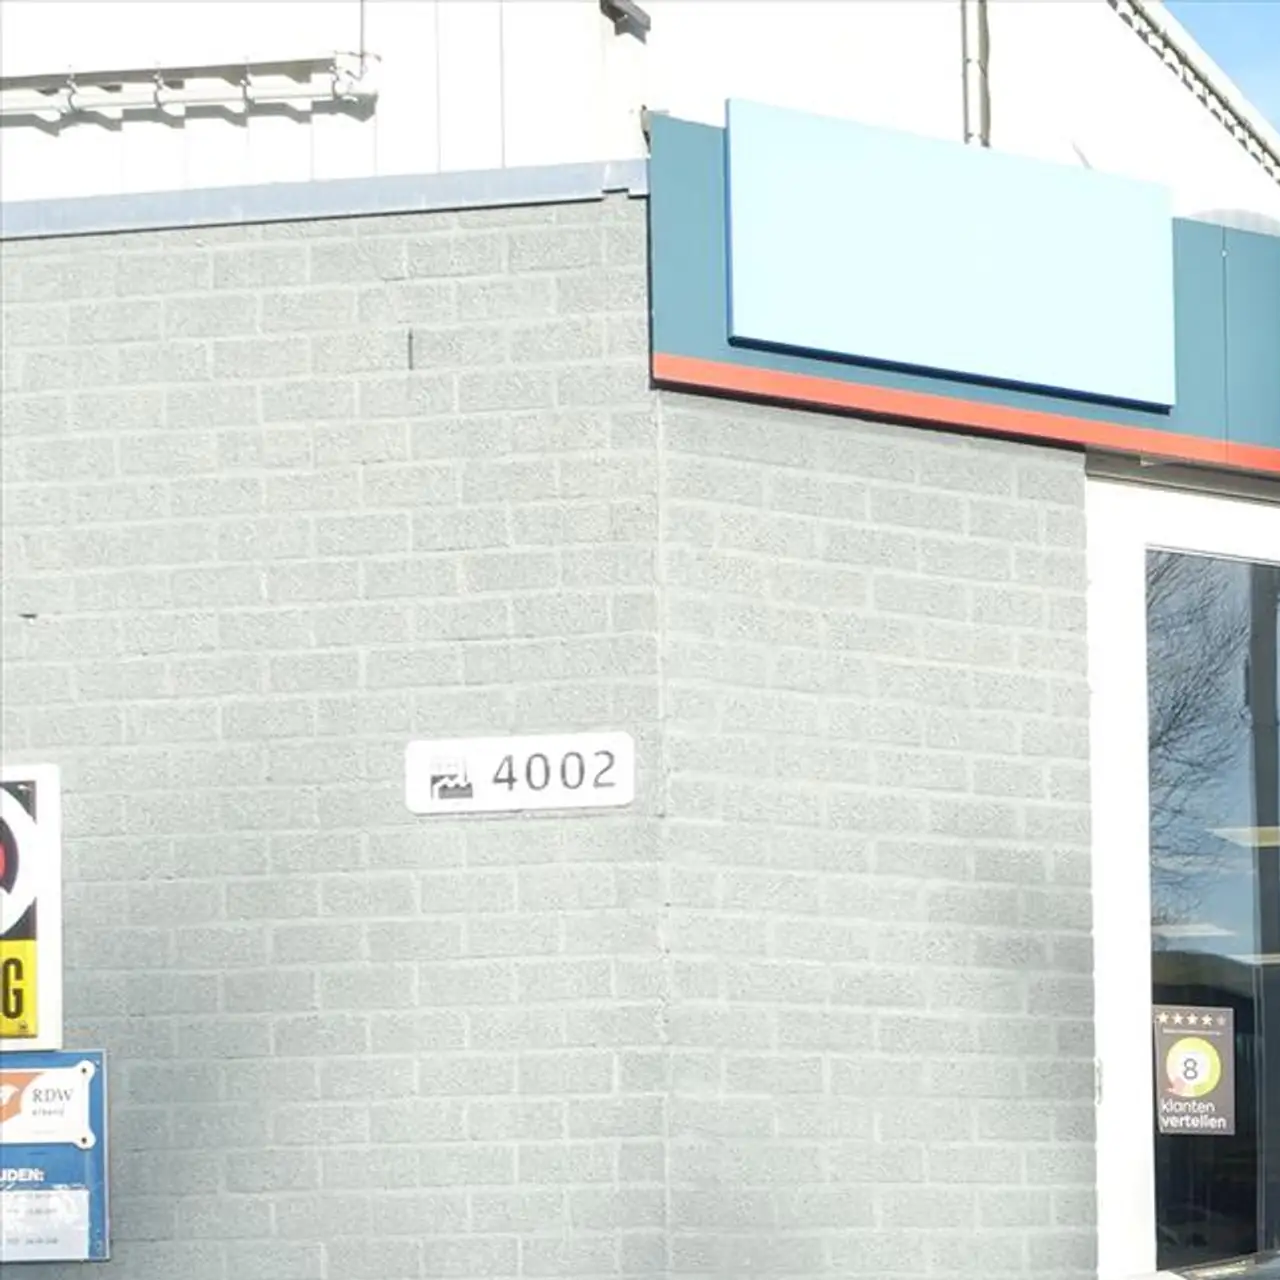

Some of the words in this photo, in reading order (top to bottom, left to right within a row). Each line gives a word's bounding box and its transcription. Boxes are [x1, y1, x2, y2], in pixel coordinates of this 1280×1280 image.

[492, 750, 616, 791] 4002
[0, 957, 23, 1019] G
[1183, 1058, 1198, 1080] 8
[32, 1088, 74, 1102] RDW
[1161, 1098, 1215, 1113] klanten
[1160, 1113, 1227, 1129] vertellen
